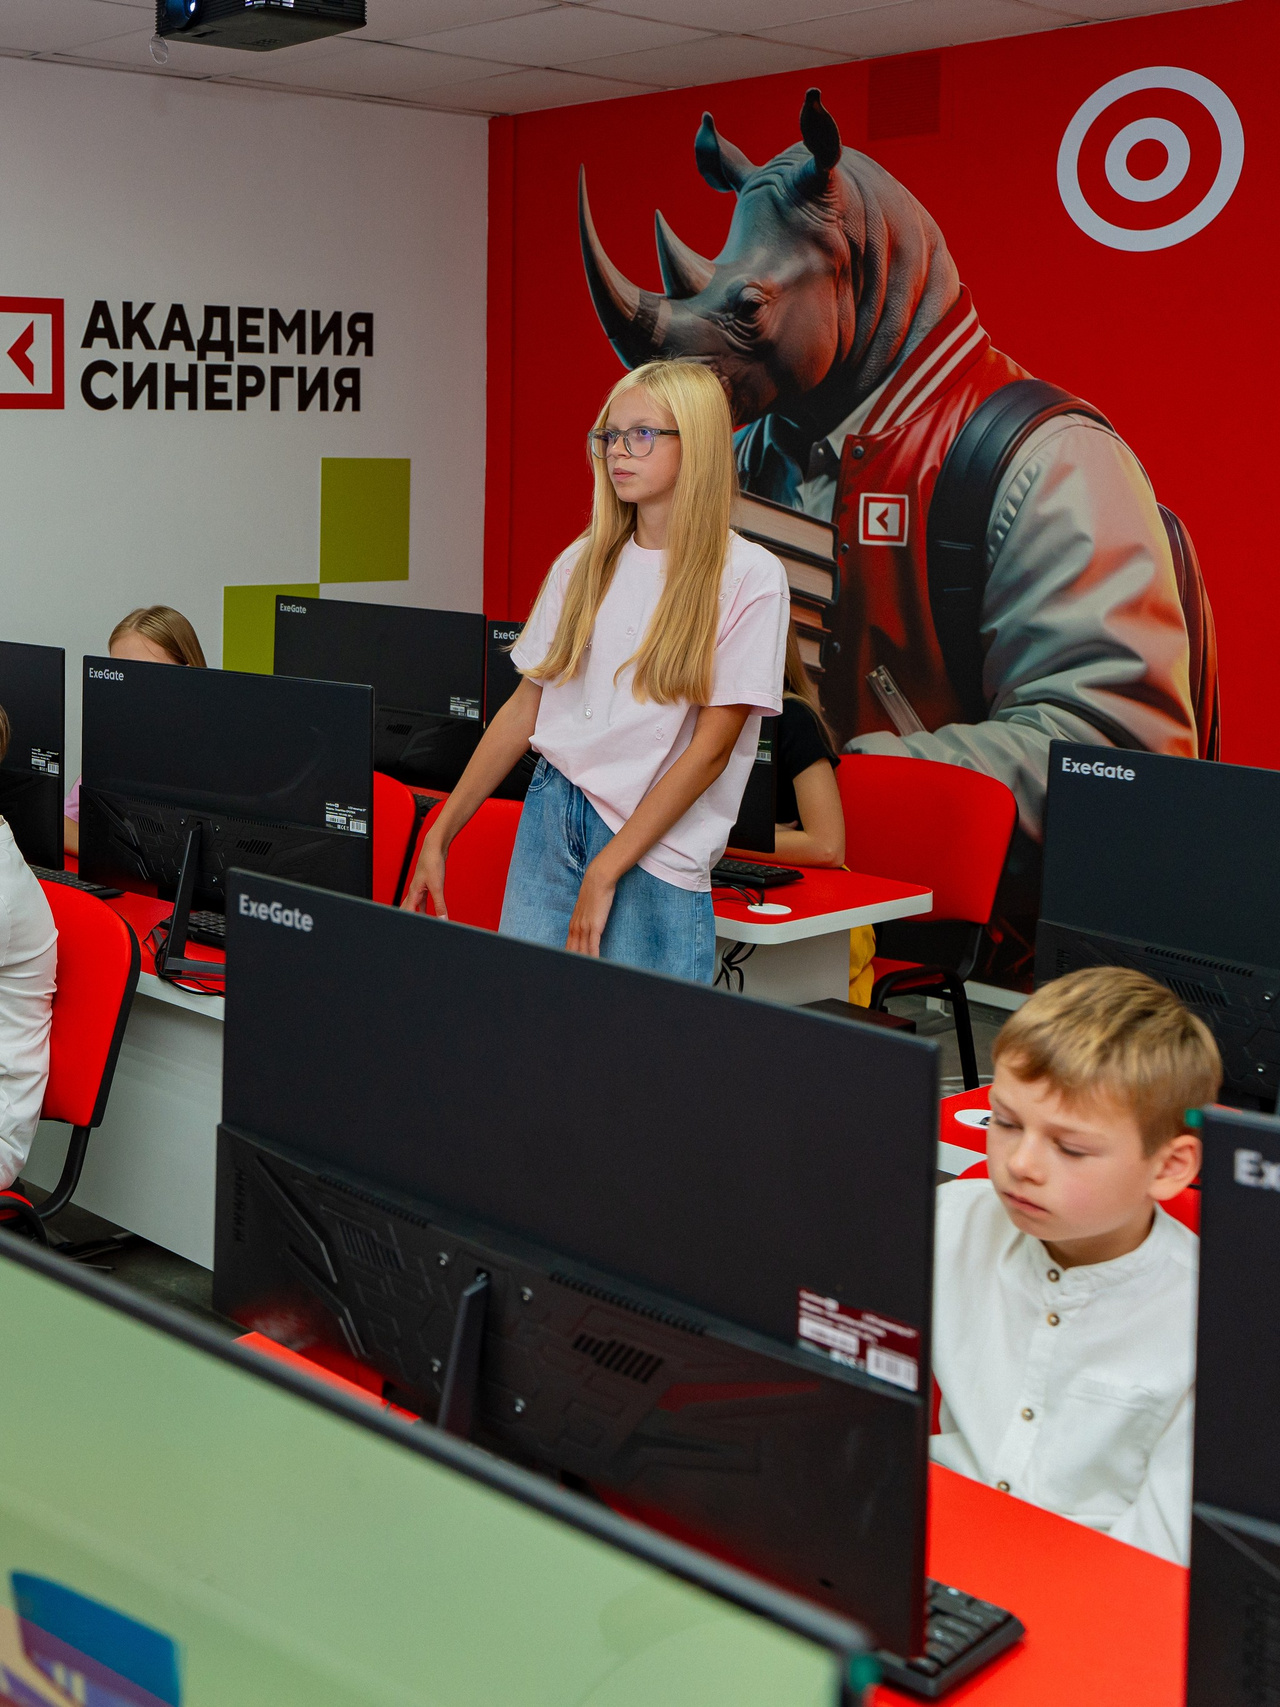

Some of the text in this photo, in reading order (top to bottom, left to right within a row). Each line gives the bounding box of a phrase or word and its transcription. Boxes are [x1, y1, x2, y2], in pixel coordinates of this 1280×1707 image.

[80, 299, 375, 362] АКАДЕМИЯ
[80, 359, 361, 412] СИНЕРГИЯ
[280, 603, 307, 614] ExeGate
[89, 668, 124, 681] ExeGate
[1062, 757, 1136, 781] ExeGate
[239, 893, 313, 932] ExeGate
